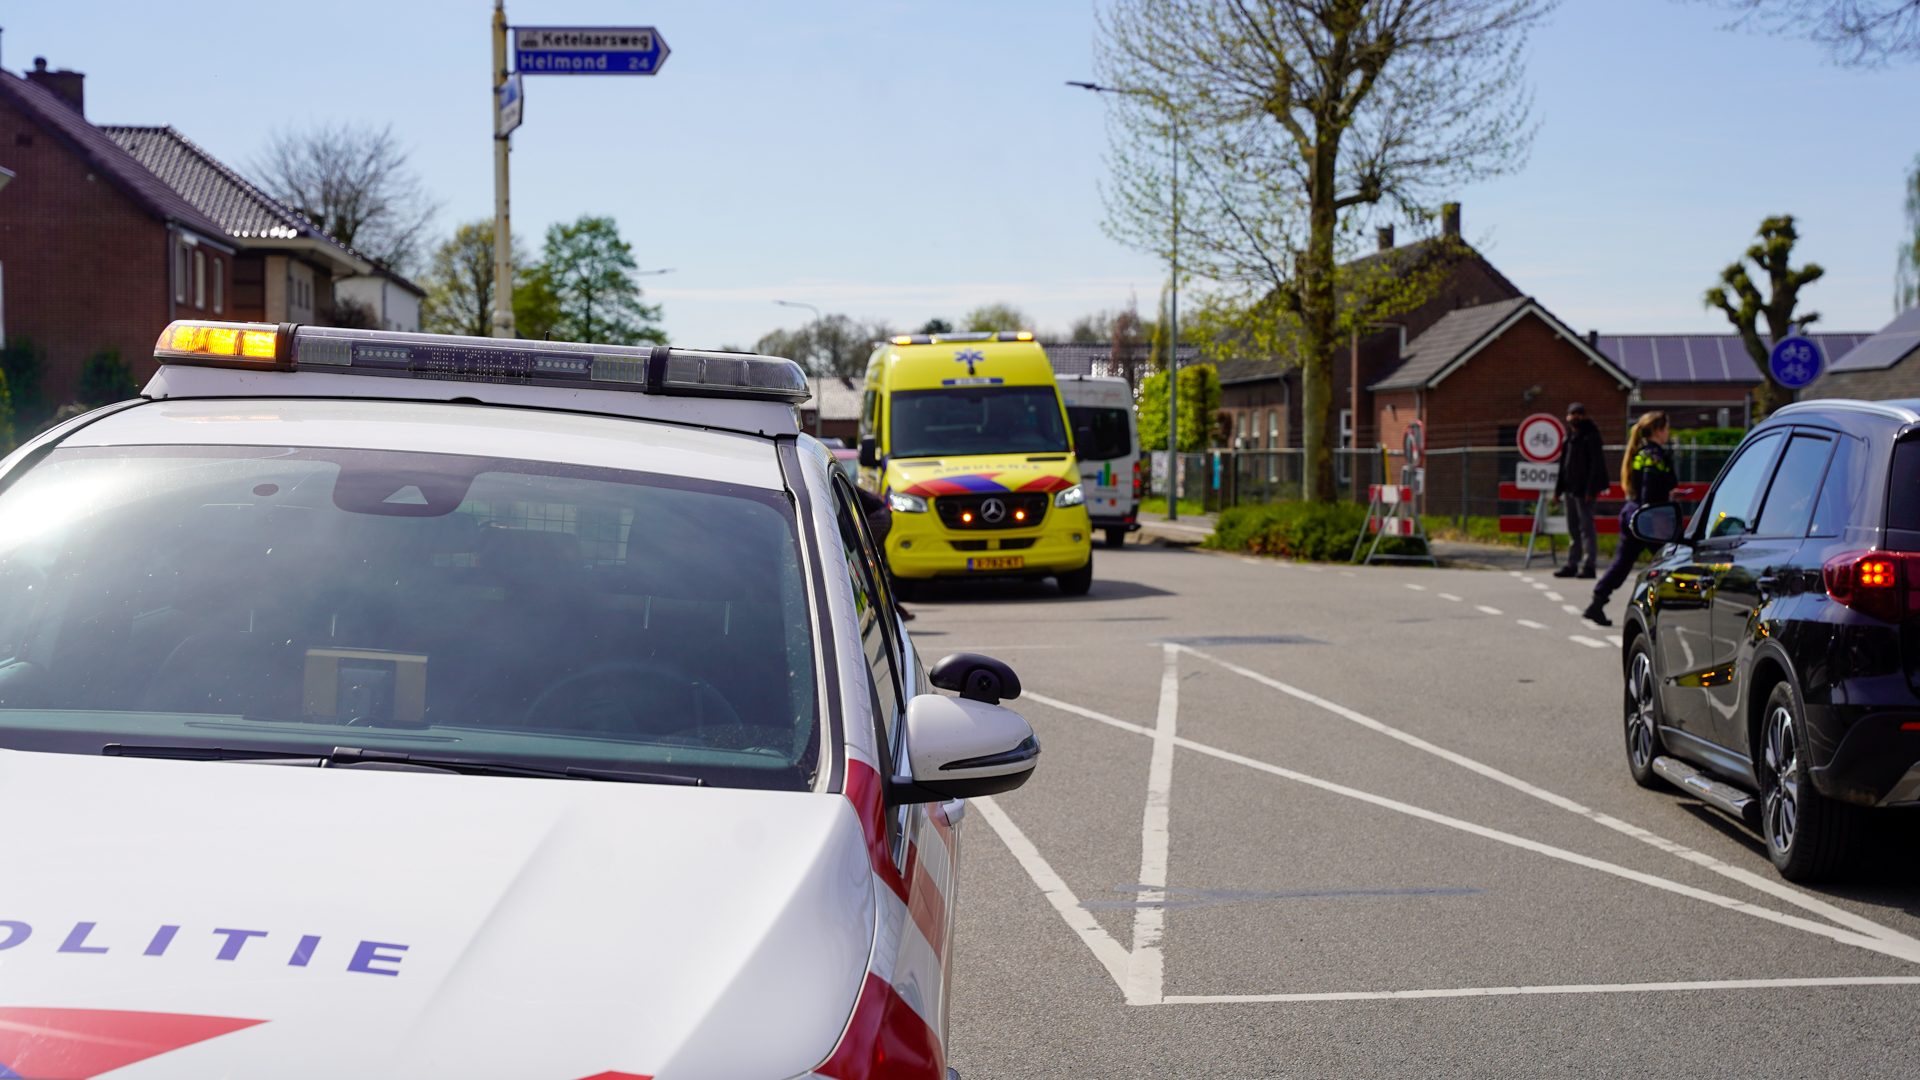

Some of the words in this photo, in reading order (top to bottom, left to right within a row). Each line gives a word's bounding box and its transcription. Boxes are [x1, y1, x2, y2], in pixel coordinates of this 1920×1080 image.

[542, 33, 649, 49] Ketelaarsweg
[520, 54, 607, 70] Helmond
[628, 57, 649, 70] 24
